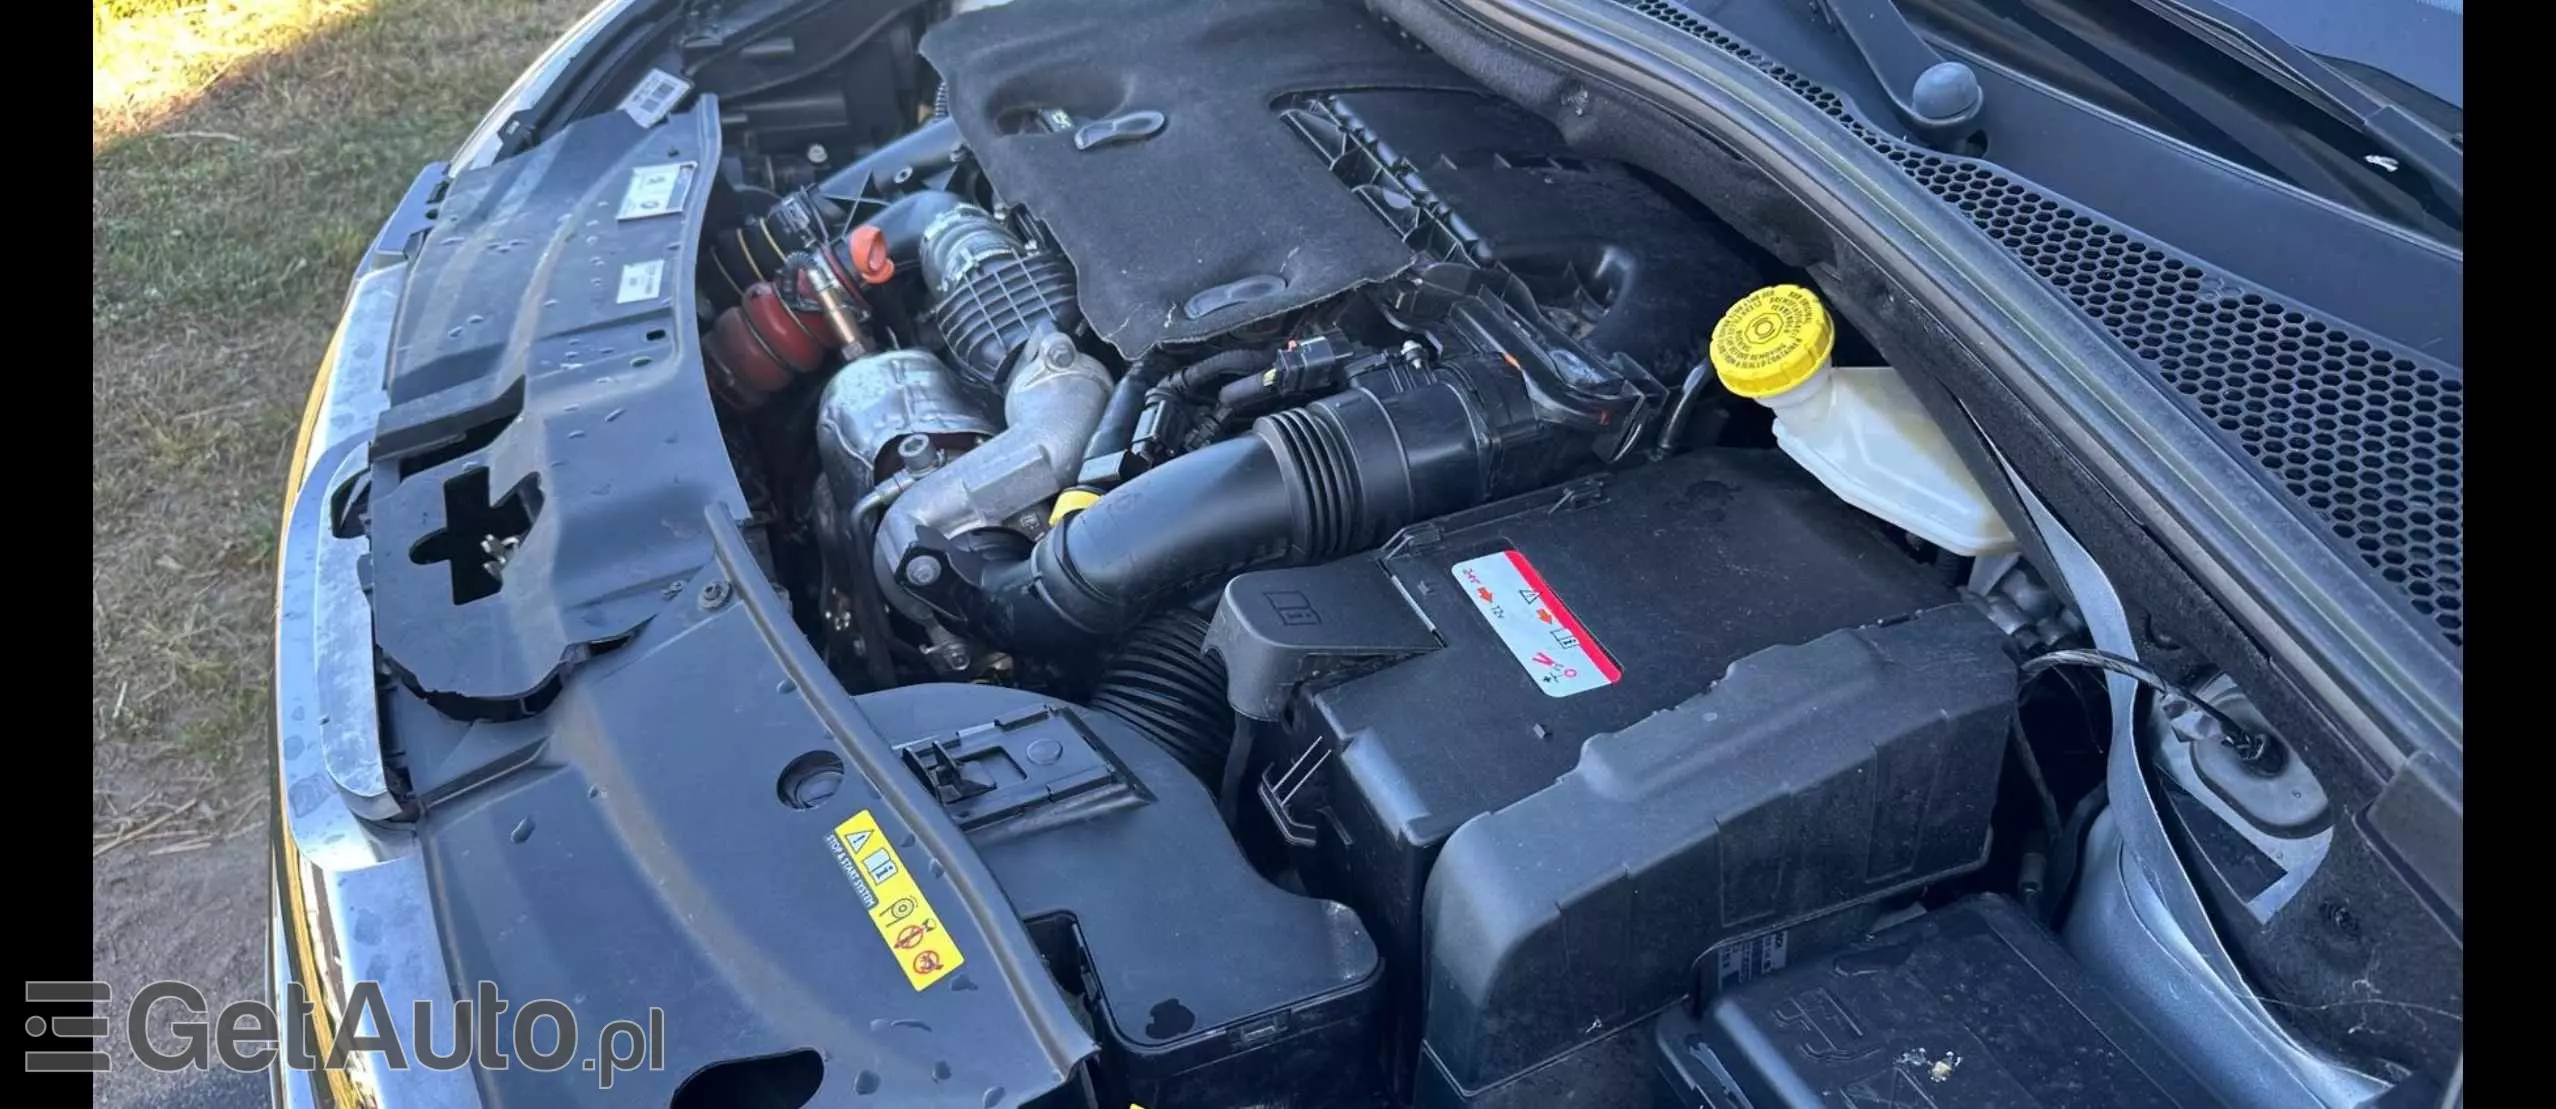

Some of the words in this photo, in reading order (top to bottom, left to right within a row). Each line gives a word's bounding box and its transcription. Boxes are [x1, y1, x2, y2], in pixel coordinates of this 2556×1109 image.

[825, 834, 842, 854] STOP
[839, 857, 859, 881] START
[853, 878, 875, 907] SYSTEM
